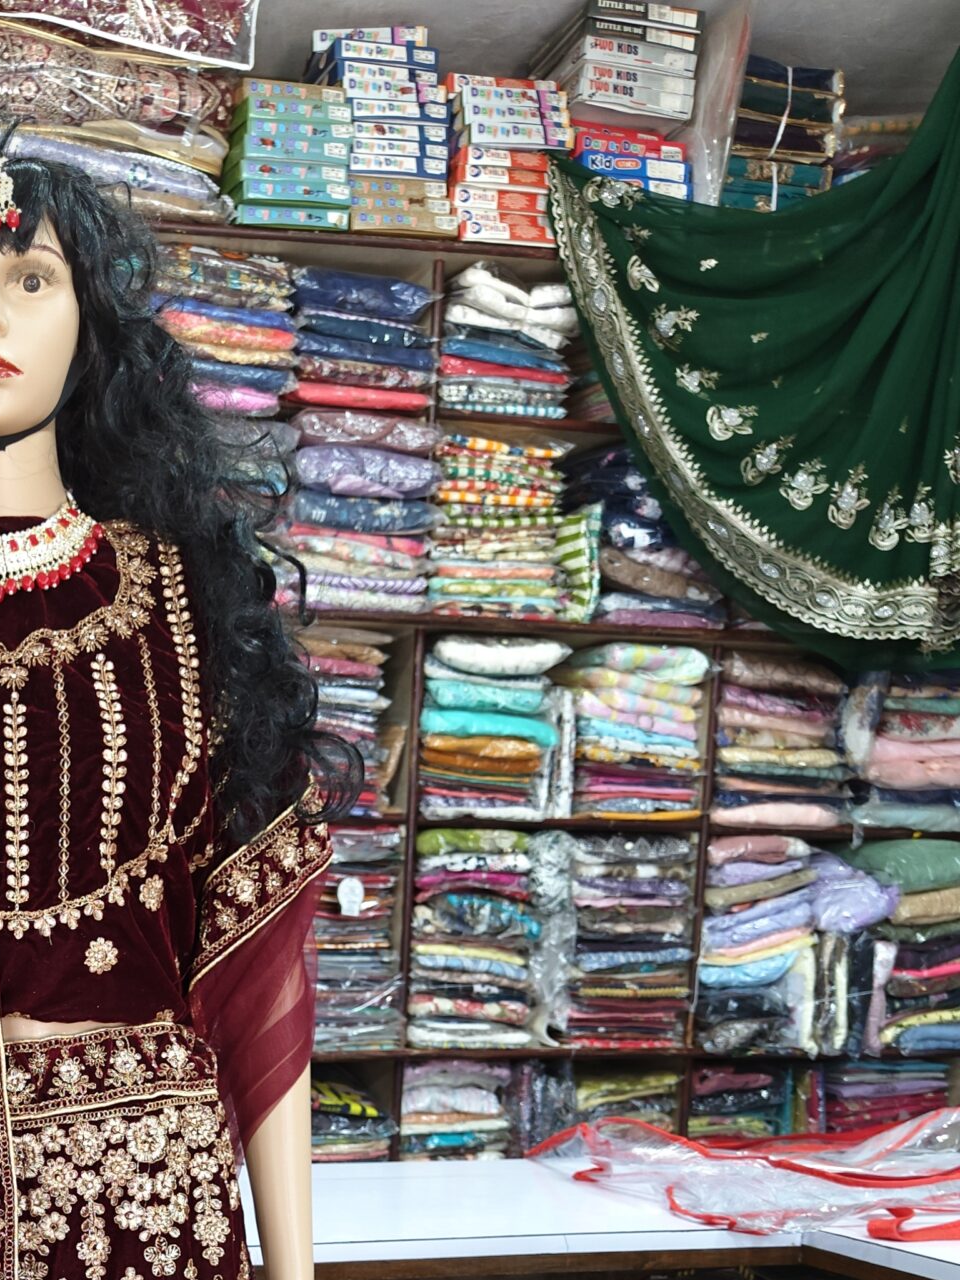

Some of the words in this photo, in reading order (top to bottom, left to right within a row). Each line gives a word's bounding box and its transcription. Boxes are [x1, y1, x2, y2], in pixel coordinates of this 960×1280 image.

[597, 0, 624, 10] LITTLE
[624, 3, 646, 13] DUDE
[596, 21, 622, 32] LITTLE
[623, 26, 644, 35] DUDE
[593, 38, 614, 51] TWO
[617, 42, 639, 56] KIDS
[593, 66, 614, 79] TWO
[616, 70, 638, 83] KIDS
[590, 80, 610, 93] TWO
[613, 84, 635, 97] KIDS
[478, 123, 499, 138] Day
[512, 125, 534, 139] Day
[583, 136, 608, 151] Day
[622, 140, 646, 156] Day
[590, 155, 614, 170] Kid
